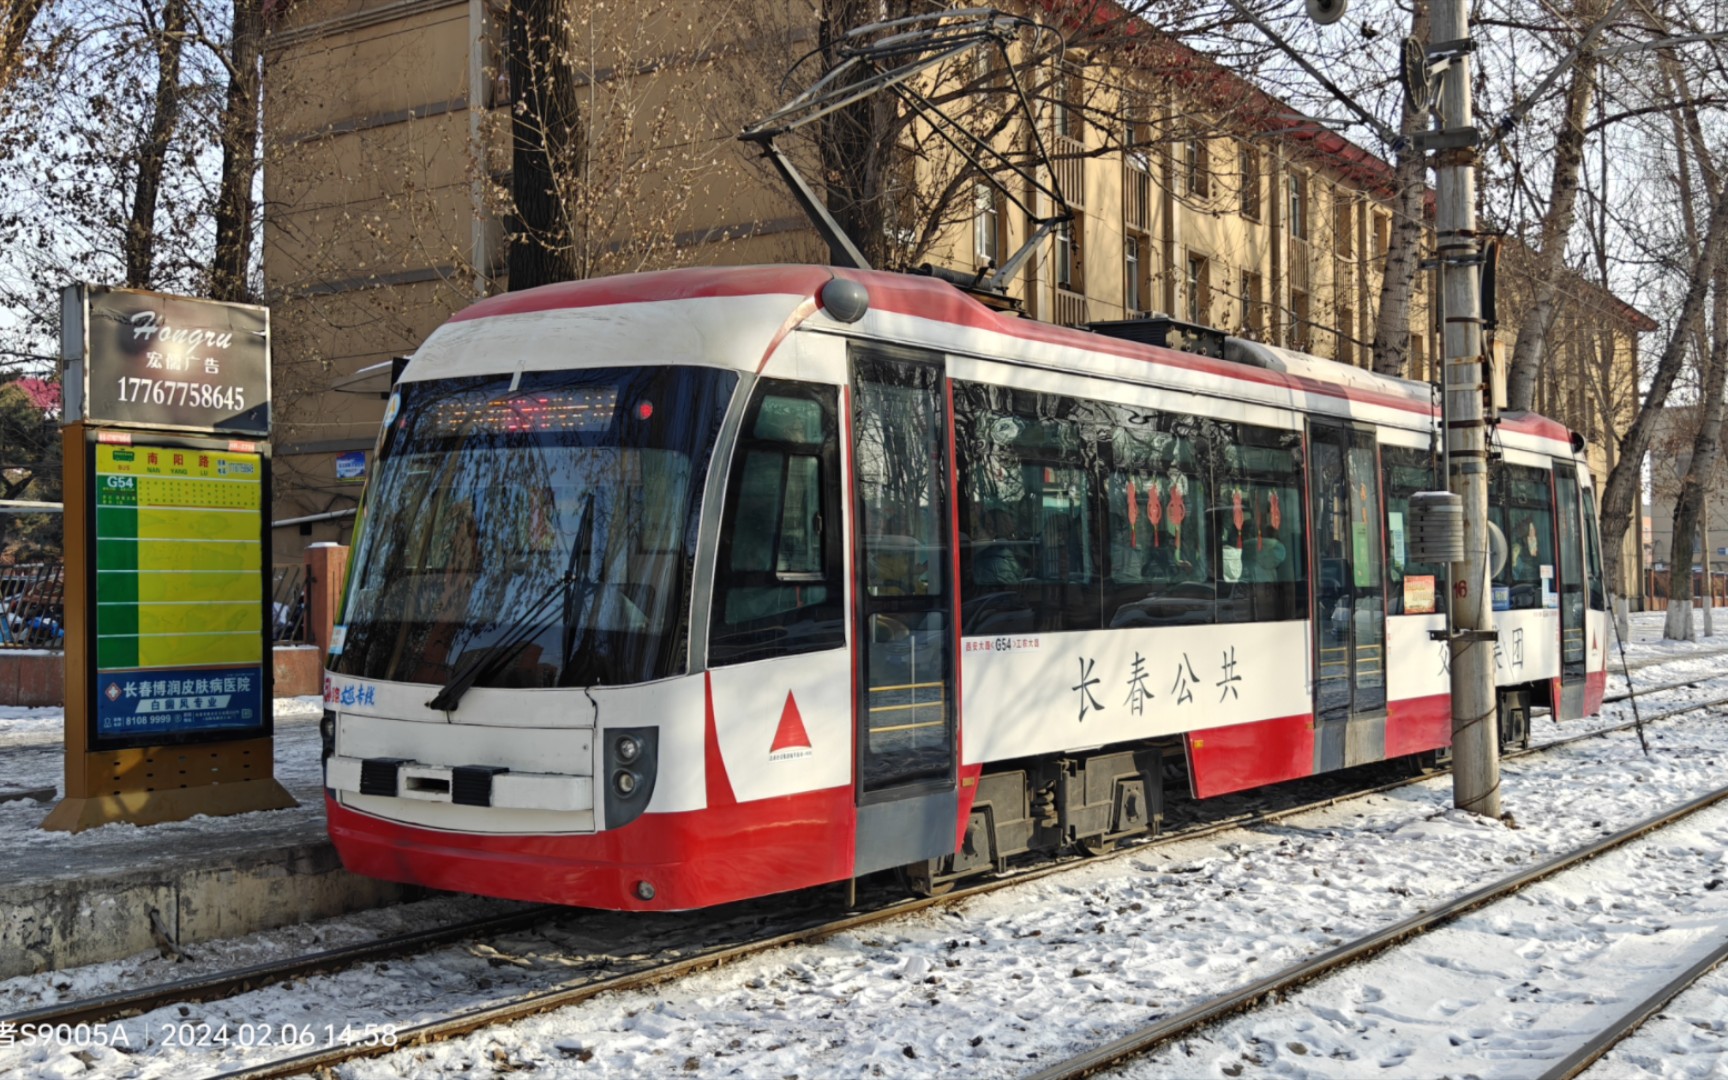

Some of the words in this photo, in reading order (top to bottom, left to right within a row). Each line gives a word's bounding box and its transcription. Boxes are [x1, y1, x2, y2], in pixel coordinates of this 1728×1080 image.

[130, 310, 233, 352] Hongru
[117, 376, 245, 412] 17767758645
[147, 452, 209, 468] 南阳路
[147, 466, 160, 474] NAN
[170, 467, 188, 476] YANG
[107, 475, 134, 489] G54
[1453, 579, 1468, 600] 16
[995, 637, 1012, 651] G54
[123, 676, 252, 699] 长春博润皮肤病医院
[1071, 645, 1242, 723] 长春公共
[125, 714, 148, 726] 8108
[150, 713, 172, 725] 9999
